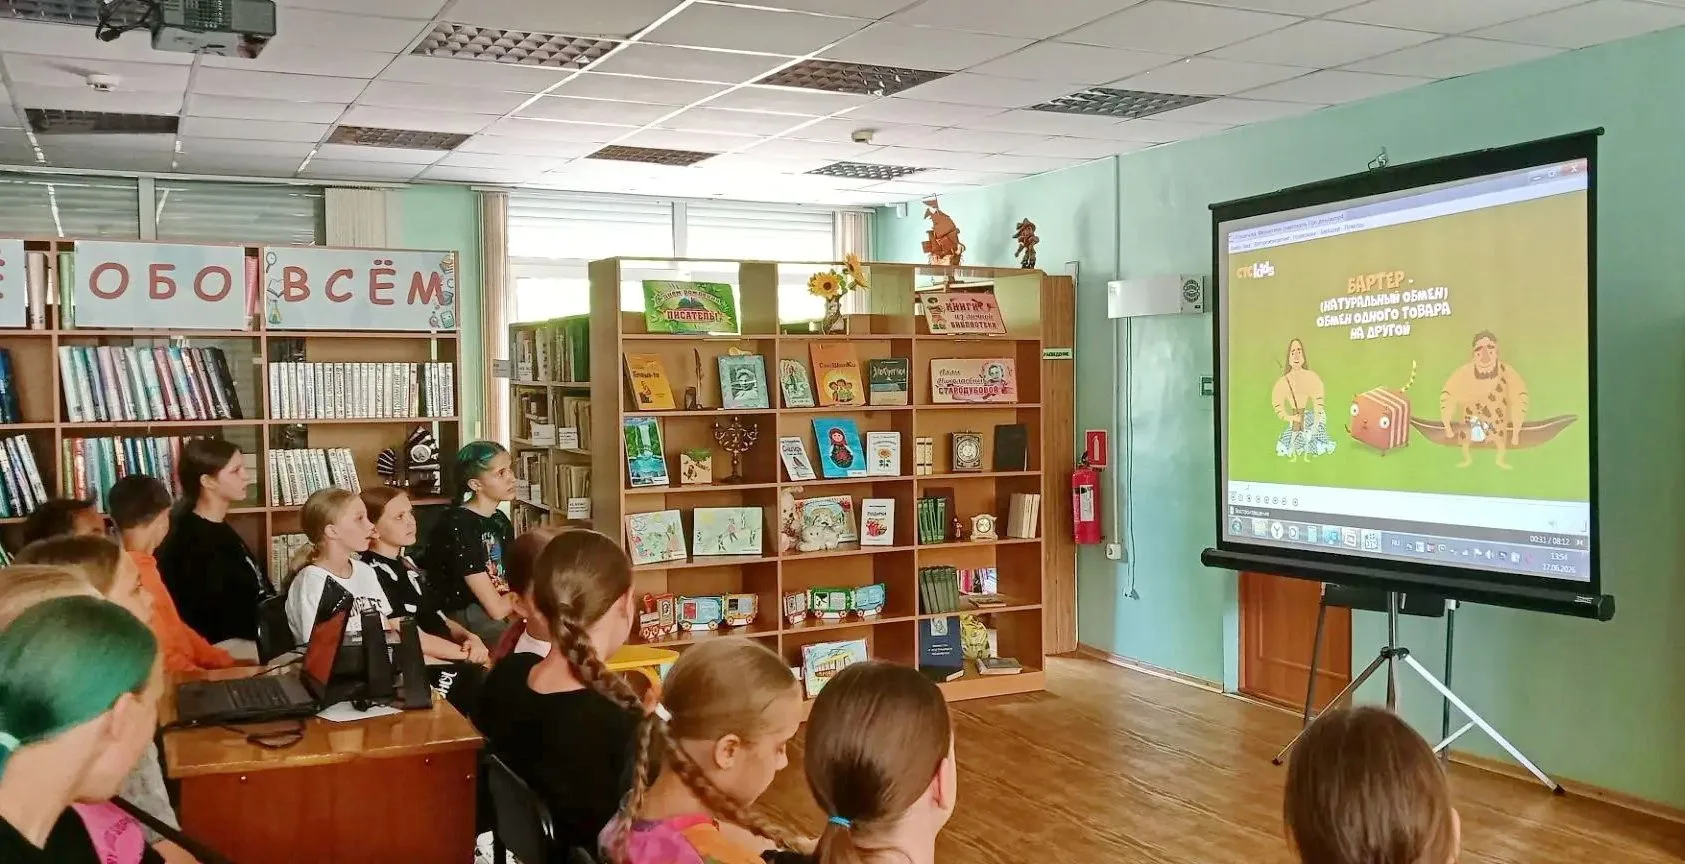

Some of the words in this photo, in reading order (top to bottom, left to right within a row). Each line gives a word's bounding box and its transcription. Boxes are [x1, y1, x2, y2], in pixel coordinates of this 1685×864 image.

[89, 262, 232, 302] ОБО
[283, 259, 447, 306] ВСЁМ
[1347, 271, 1405, 294] БАРТЕР
[1320, 291, 1401, 313] (НАТУРАЛЬНЫЙ
[1402, 286, 1448, 302] ОБМЕН)
[1316, 313, 1352, 327] ОБМЕН
[1353, 308, 1399, 324] ОДНОГО
[1401, 302, 1452, 319] ТОВАРА
[1350, 326, 1365, 340] НА
[1366, 322, 1411, 339] ДРУГОЙ
